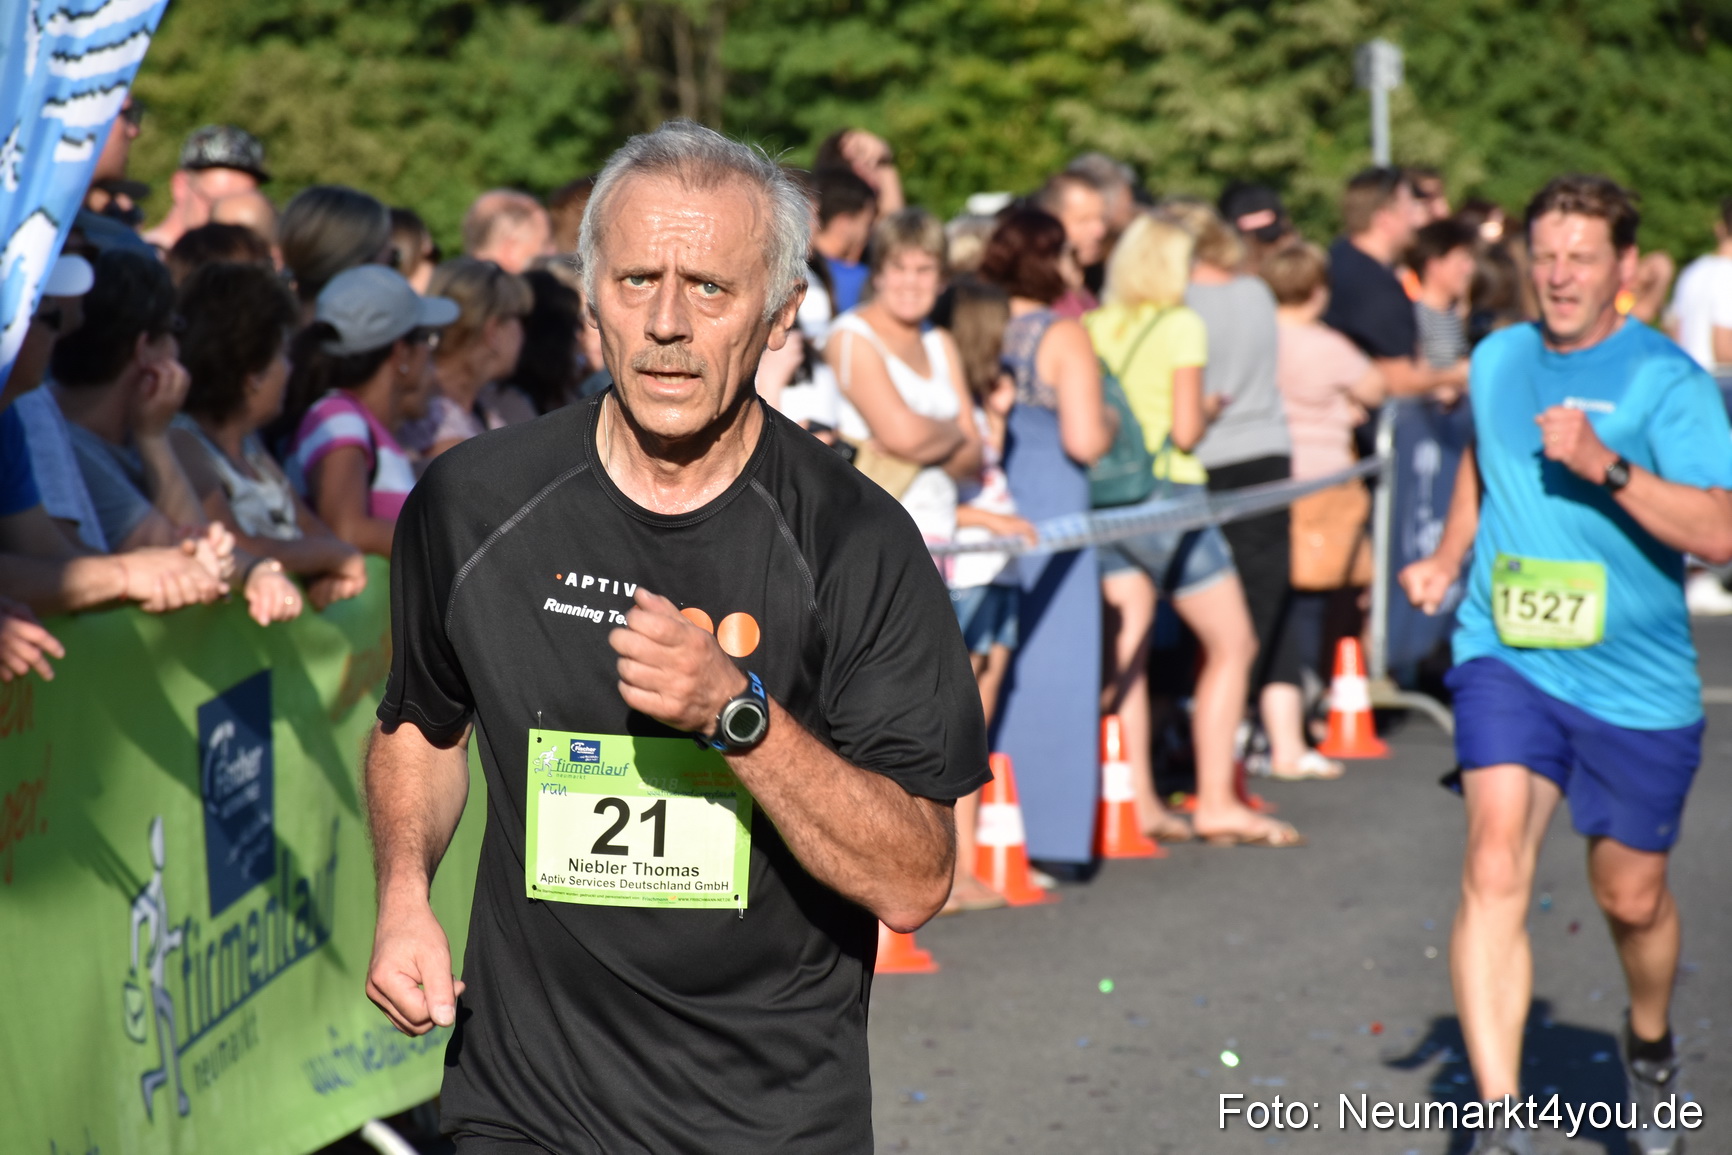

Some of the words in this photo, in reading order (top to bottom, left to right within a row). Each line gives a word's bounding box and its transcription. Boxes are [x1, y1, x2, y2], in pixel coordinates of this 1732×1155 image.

[565, 572, 637, 597] APTIV
[544, 598, 604, 623] Running
[608, 610, 628, 626] Te
[1501, 589, 1584, 622] 1527
[556, 758, 630, 776] firmenlauf
[591, 797, 667, 858] 21
[568, 858, 627, 875] Niebler
[633, 862, 700, 877] Thomas
[540, 873, 566, 885] Aptiv
[569, 876, 616, 888] Services
[620, 879, 693, 891] Deutschland
[695, 881, 729, 891] GmbH
[182, 815, 340, 1040] firmenlauf
